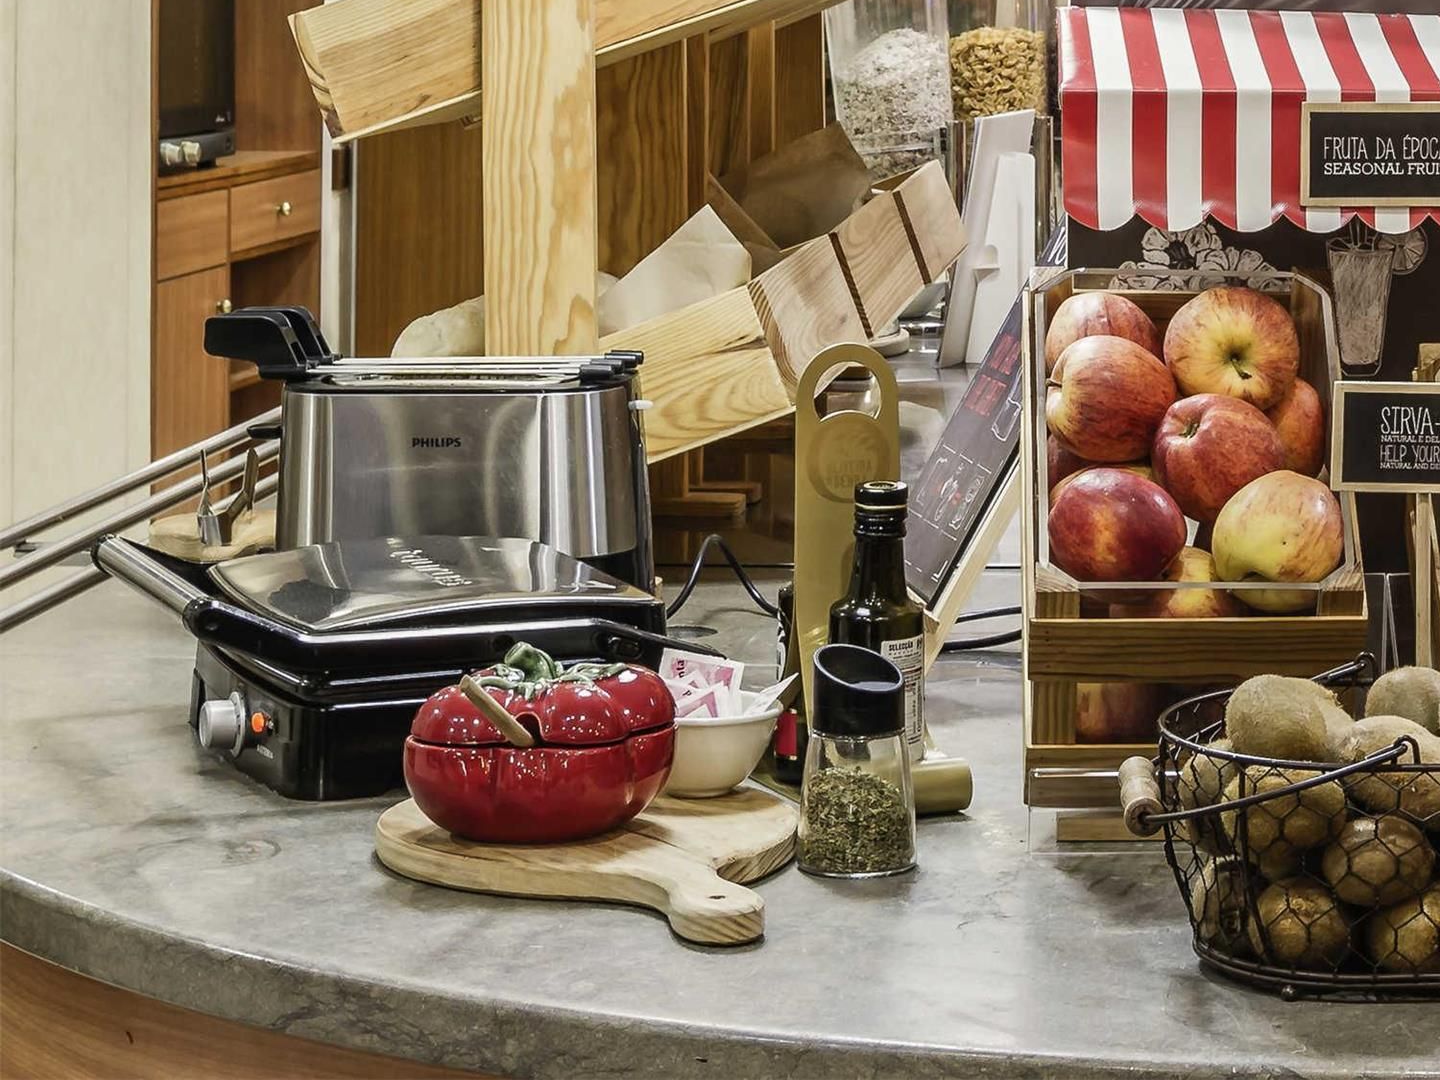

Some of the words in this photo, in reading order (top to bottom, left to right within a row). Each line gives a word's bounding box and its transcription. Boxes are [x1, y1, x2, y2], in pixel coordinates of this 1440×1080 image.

[1323, 136, 1369, 160] FRUTA
[1375, 136, 1397, 160] DA
[1323, 162, 1404, 176] SEASONAL
[411, 437, 462, 448] PHILIPS
[1380, 444, 1408, 463] HELP
